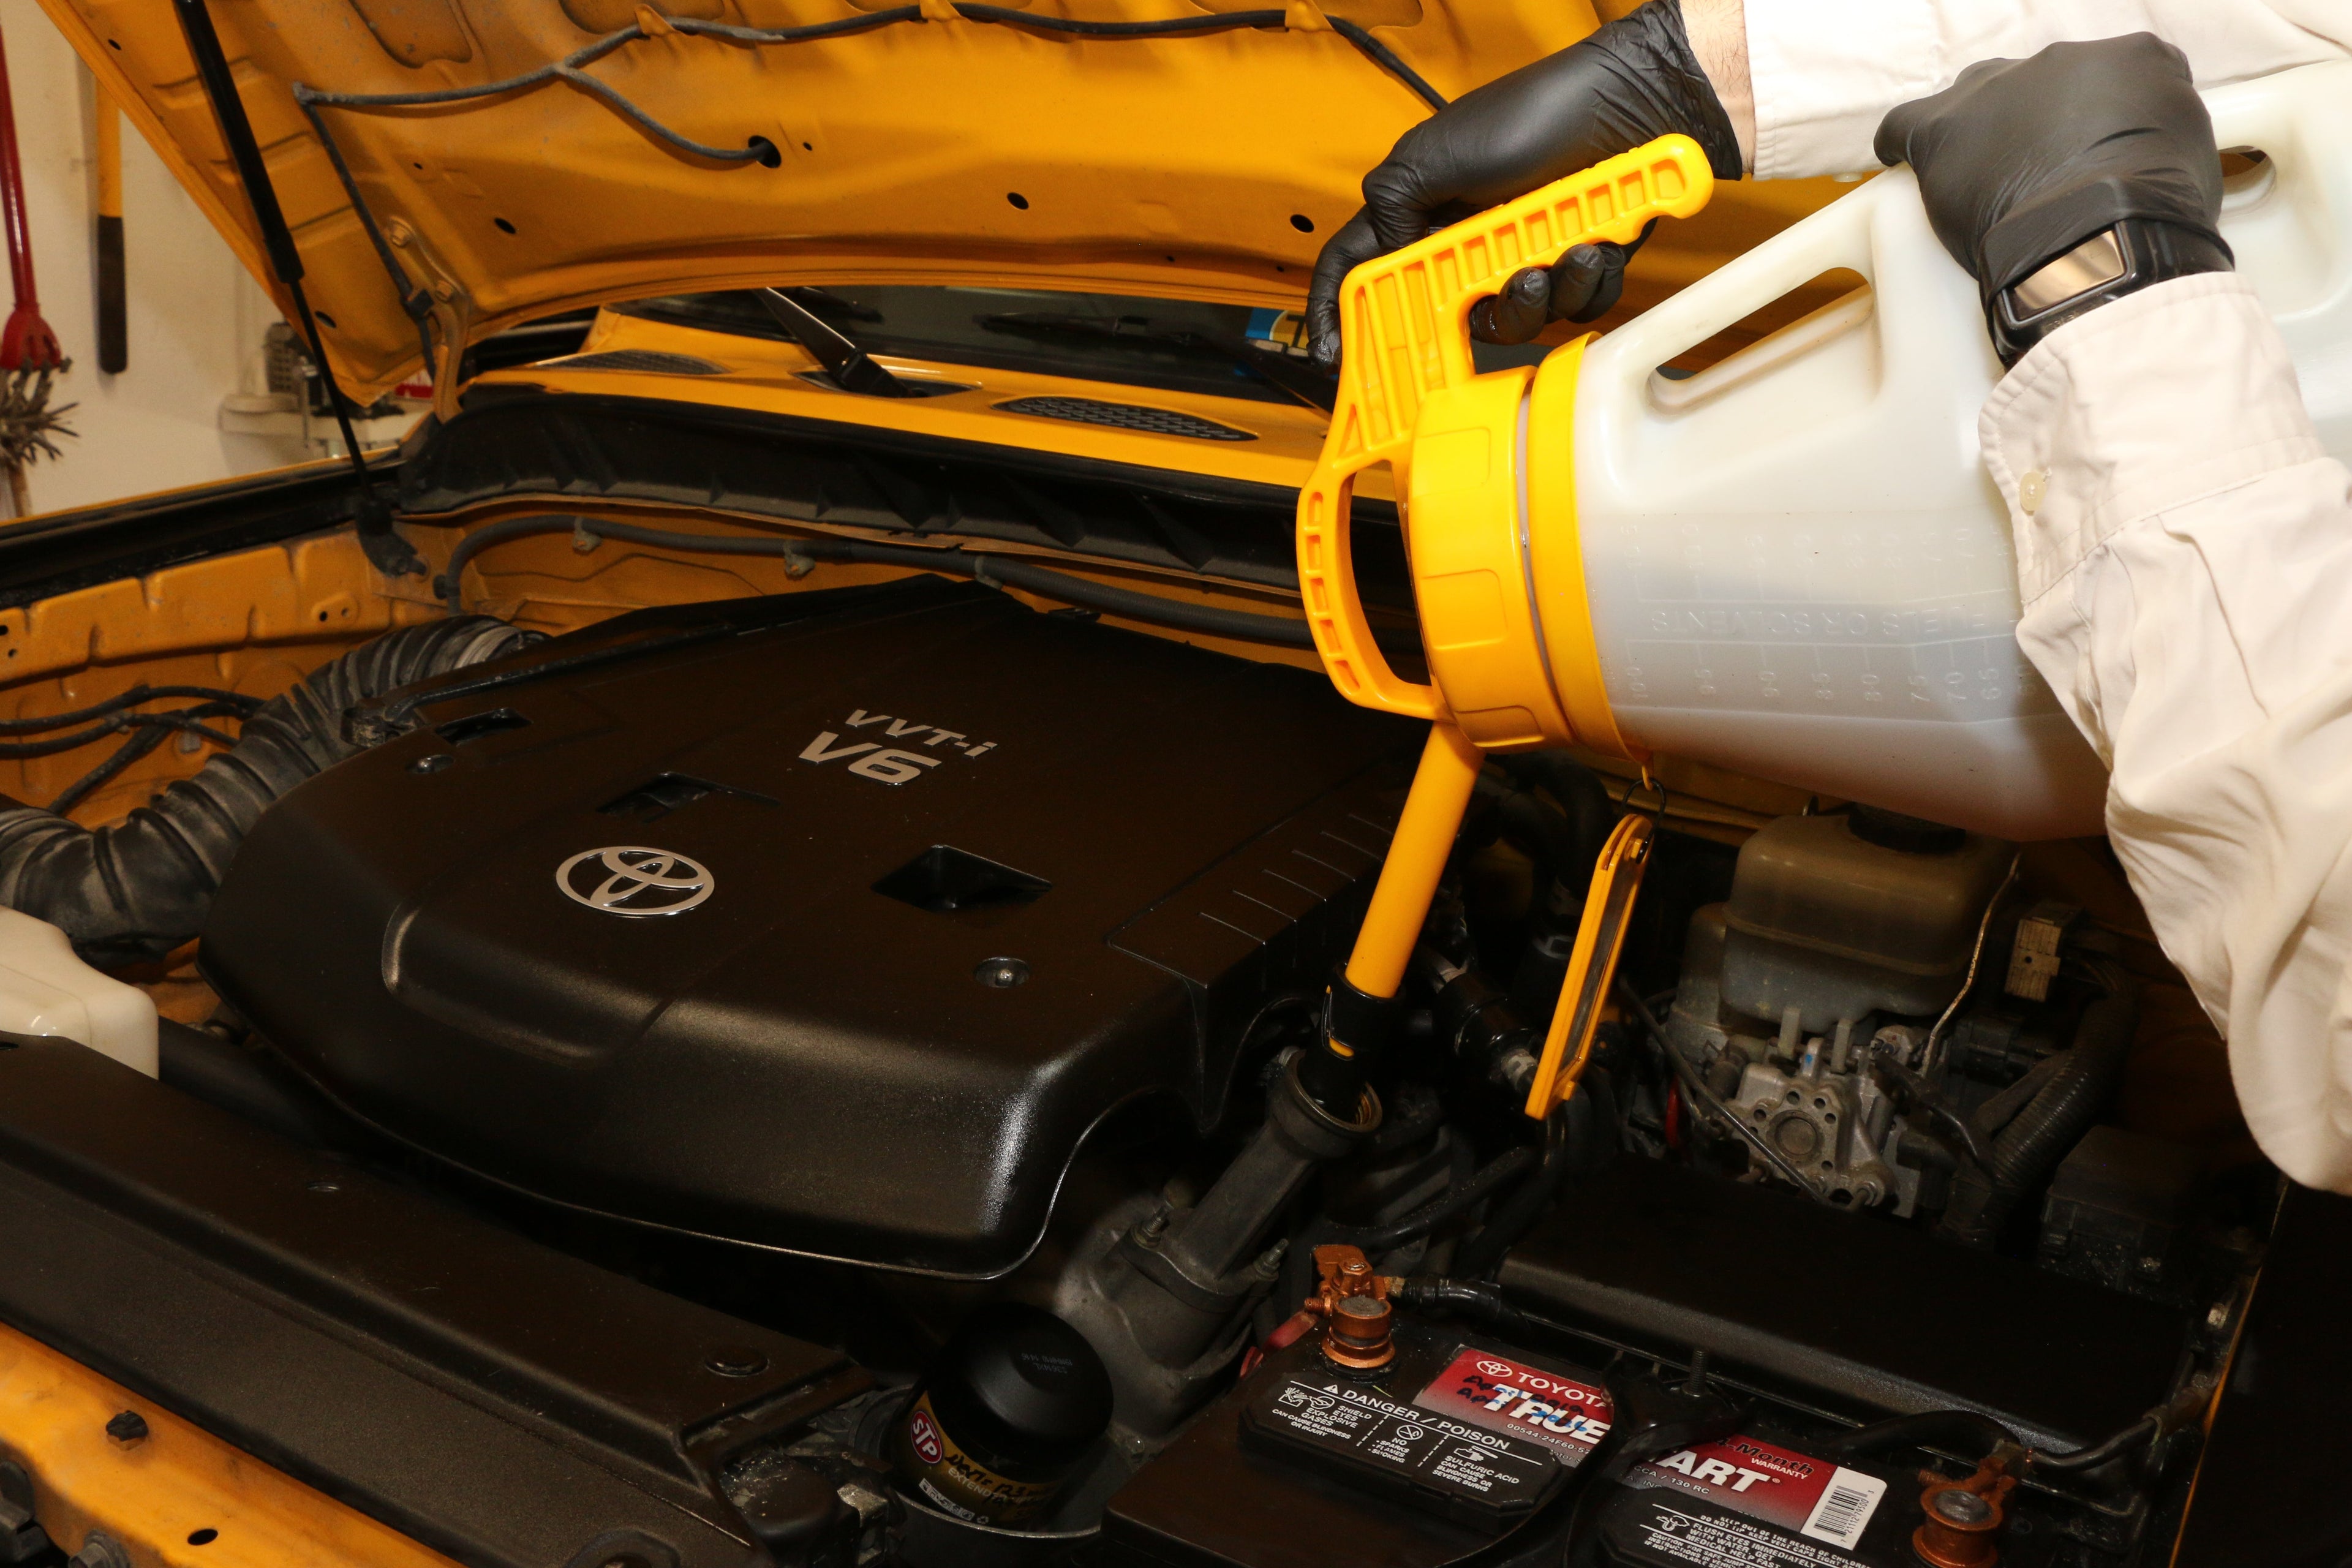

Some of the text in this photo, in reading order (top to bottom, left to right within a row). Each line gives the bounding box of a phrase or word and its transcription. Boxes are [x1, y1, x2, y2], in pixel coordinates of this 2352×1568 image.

[845, 709, 998, 759] VVT-i
[799, 731, 942, 785] V6
[1272, 1409, 1351, 1439] CAN CAUSE BLINDNESS
[1301, 1412, 1334, 1426] GASES
[1306, 1408, 1358, 1428] EXPLOSIVE
[1333, 1410, 1358, 1421] EYES
[1338, 1405, 1372, 1420] SHIELD
[1343, 1390, 1420, 1420] DANGER
[1438, 1421, 1510, 1450] POISON
[1483, 1383, 1611, 1444] TRUE
[912, 1418, 937, 1458] STP
[1302, 1425, 1328, 1437] INJURY
[1392, 1438, 1407, 1446] NO
[1371, 1449, 1405, 1463] SMOKING
[1376, 1444, 1406, 1458] FLAMES
[1381, 1440, 1410, 1453] SPARKS
[1436, 1464, 1493, 1488] BLINDNESS OR
[1441, 1461, 1486, 1479] CAN CAUSE
[1445, 1455, 1520, 1485] SULFURIC ACID
[1751, 1457, 1808, 1480] WARRANTY
[1432, 1469, 1490, 1493] SEVERE BURNS
[1671, 1477, 1691, 1488] 130
[1692, 1485, 1710, 1494] RC
[1690, 1528, 1715, 1541] WITH
[1755, 1551, 1775, 1561] GET
[1692, 1523, 1817, 1568] FLUSH EYES IMMEDIATELY
[1713, 1520, 1729, 1528] NOT
[1748, 1532, 1769, 1541] KEEP
[1771, 1539, 1791, 1549] VENT
[1793, 1547, 1815, 1558] CAPS
[1817, 1555, 1841, 1566] TIGHT
[1720, 1517, 1740, 1526] KEEP
[1741, 1524, 1757, 1533] OUT
[1773, 1534, 1788, 1543] THE
[1790, 1540, 1816, 1553] REACH
[1648, 1536, 1702, 1558] INSTRUCTIONS
[1668, 1549, 1708, 1566] AVAILABLE
[1686, 1534, 1781, 1568] MEDICAL HELP FAST
[1687, 1545, 1702, 1553] FOR
[1703, 1550, 1722, 1561] SAFE
[1723, 1558, 1744, 1567] JUMP
